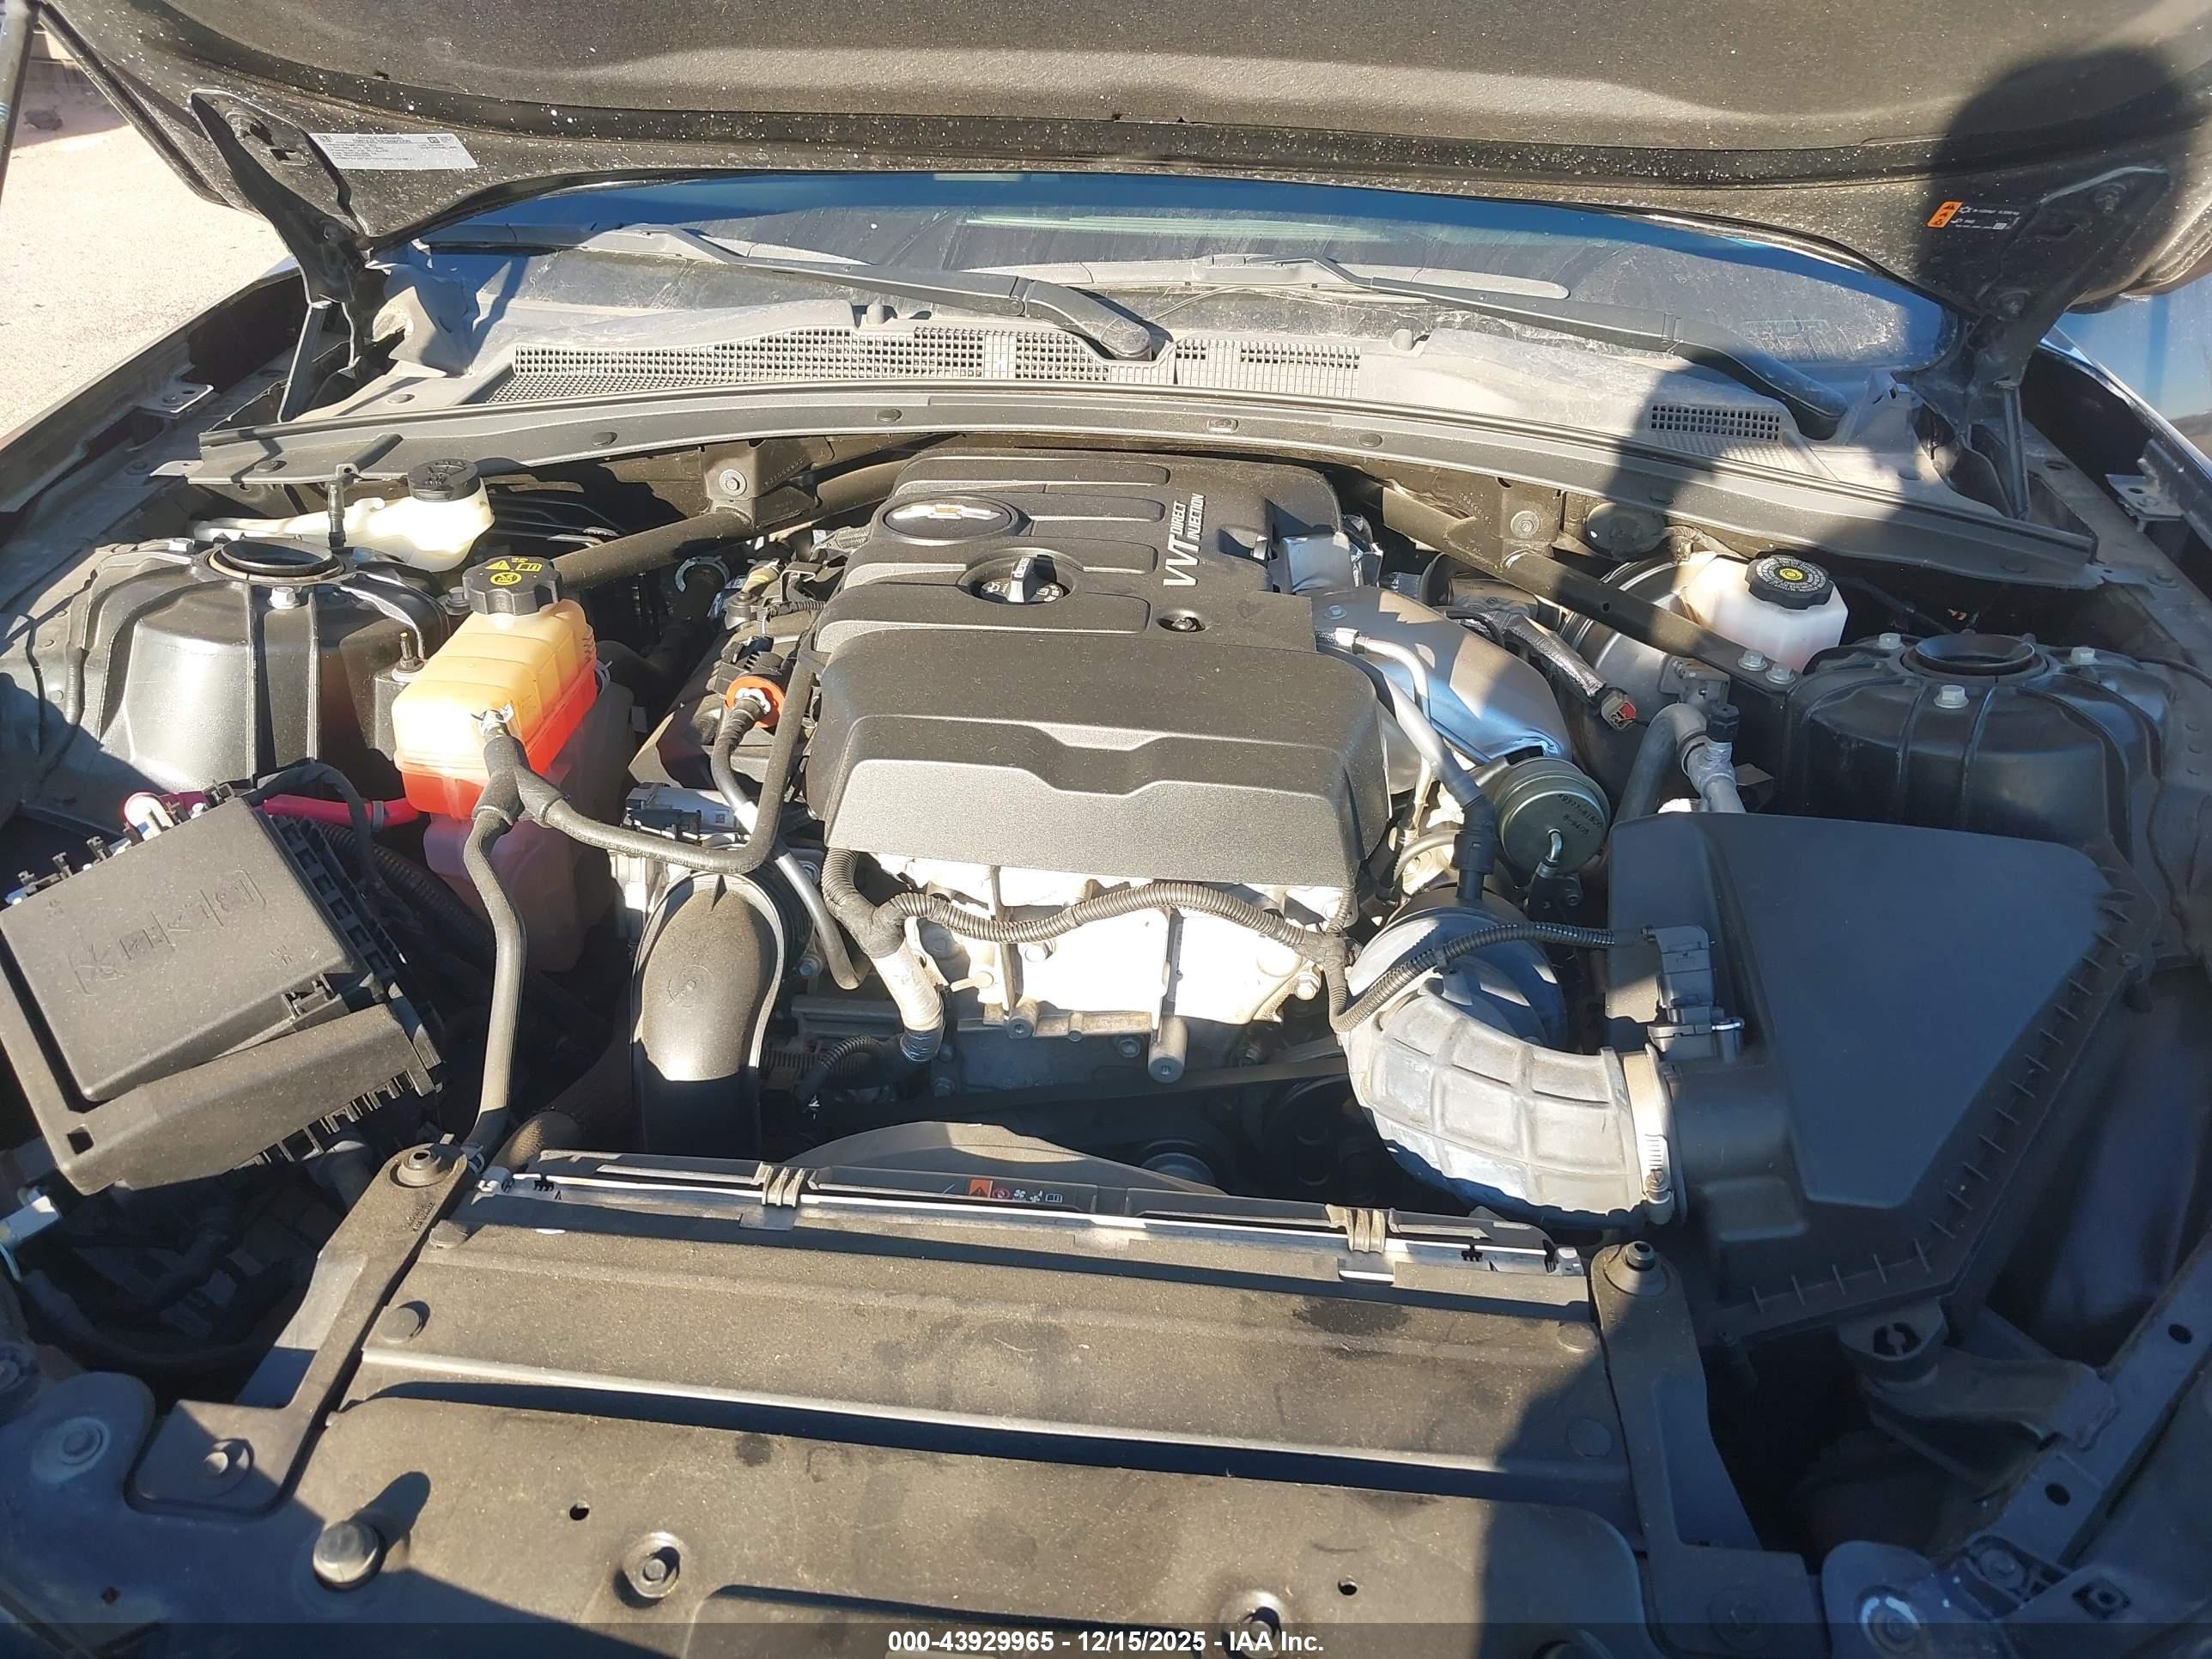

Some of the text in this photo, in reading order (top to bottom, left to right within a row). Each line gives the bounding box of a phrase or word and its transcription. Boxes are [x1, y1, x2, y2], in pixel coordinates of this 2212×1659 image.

[1170, 501, 1187, 537] DIRECT
[1187, 493, 1205, 541] INJECTION
[1164, 533, 1200, 587] VVT
